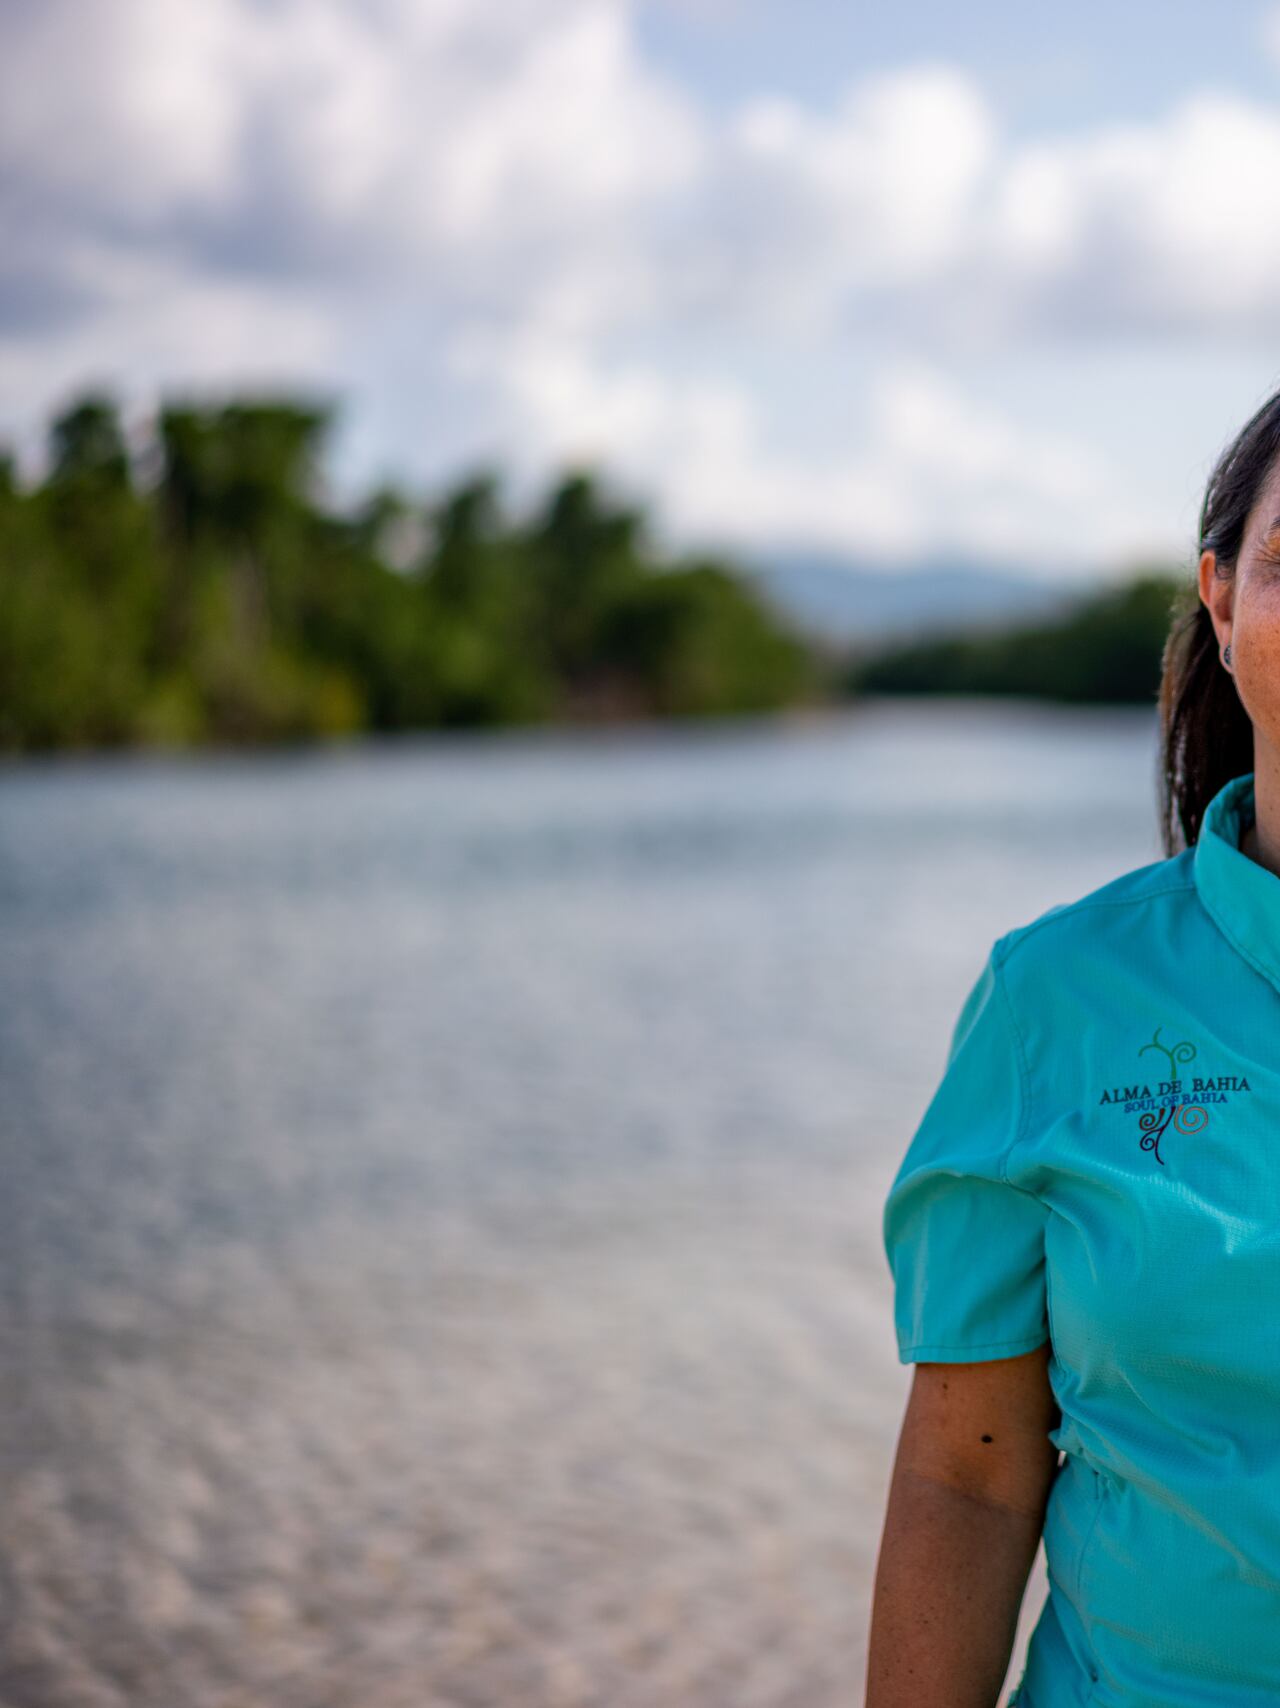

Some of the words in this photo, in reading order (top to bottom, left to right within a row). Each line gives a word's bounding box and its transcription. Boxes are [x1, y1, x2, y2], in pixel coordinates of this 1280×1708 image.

[1100, 1085, 1151, 1104] ALMA
[1158, 1081, 1182, 1096] DE
[1192, 1077, 1250, 1092] BAHIA
[1124, 1099, 1158, 1113] SOUL
[1161, 1094, 1180, 1107] OF
[1182, 1092, 1228, 1105] BAHIA
